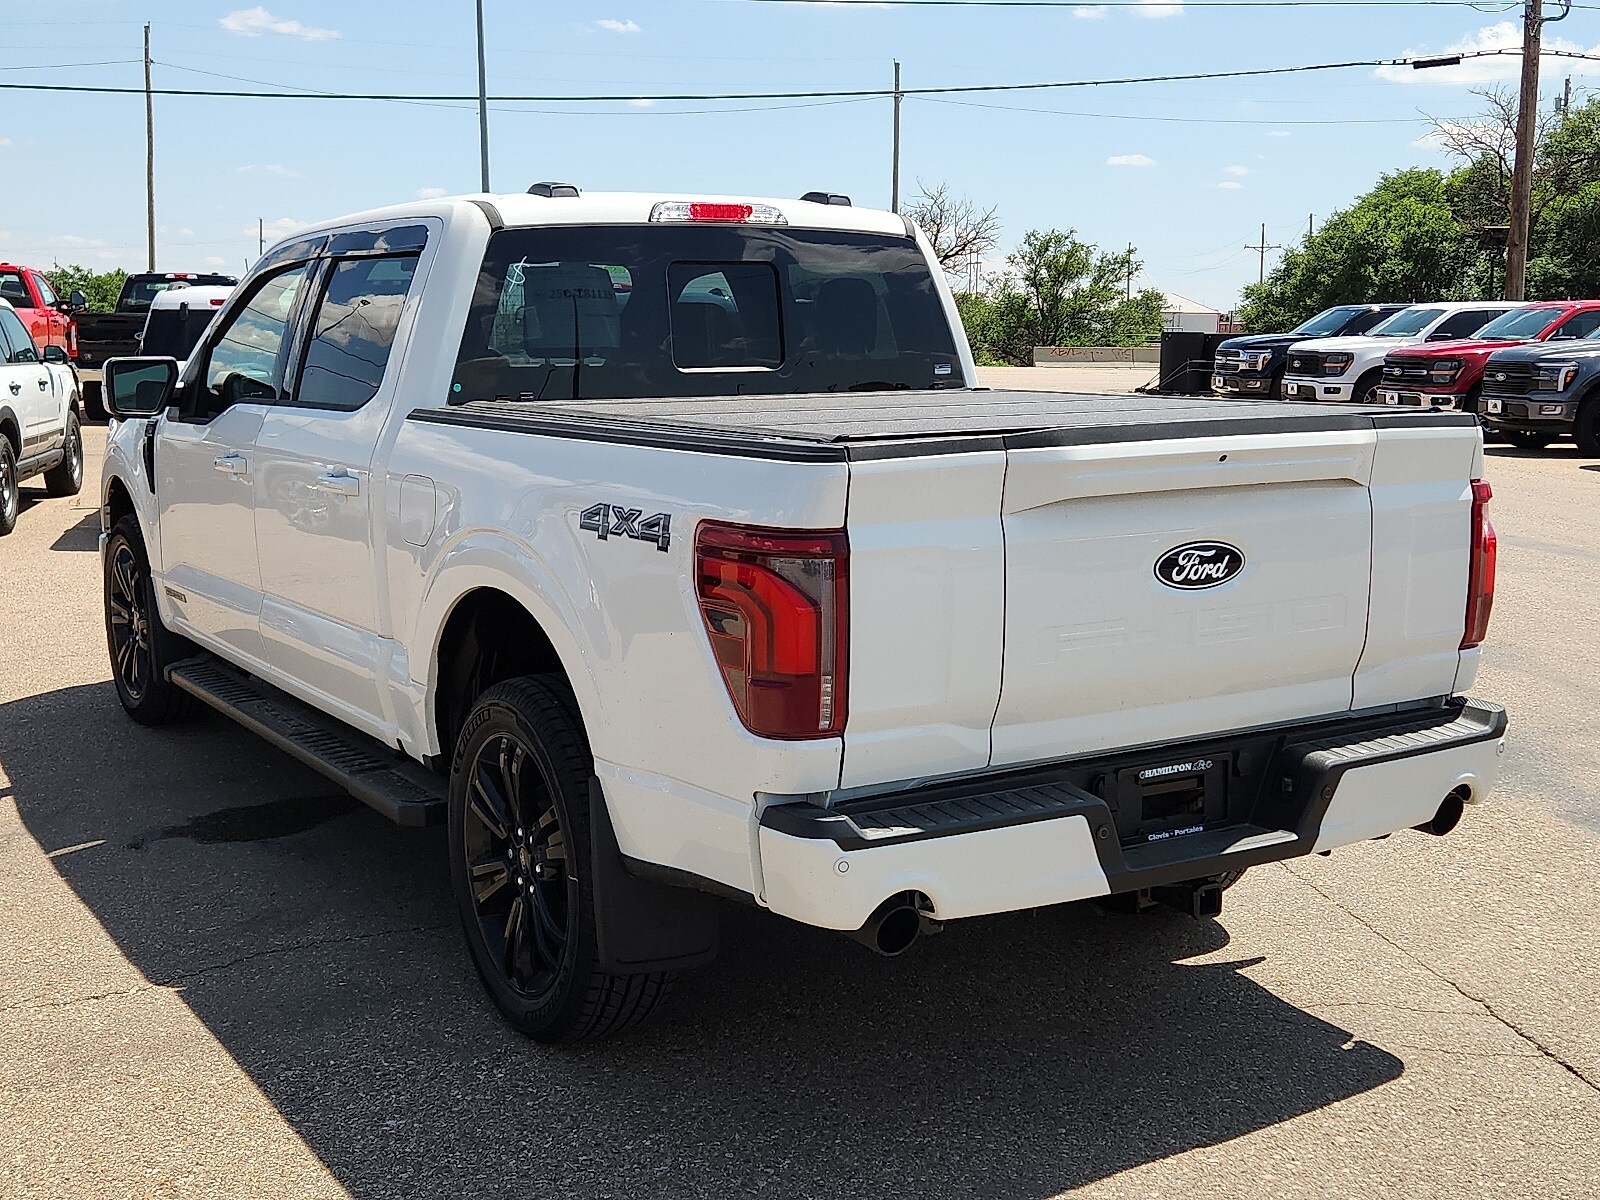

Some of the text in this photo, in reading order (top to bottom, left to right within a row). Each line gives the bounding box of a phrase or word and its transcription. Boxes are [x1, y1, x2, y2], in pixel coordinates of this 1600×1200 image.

[1171, 549, 1230, 582] Ford
[1144, 762, 1193, 778] HAMILTON
[1148, 831, 1170, 841] Clovis
[1174, 826, 1204, 836] Portales
